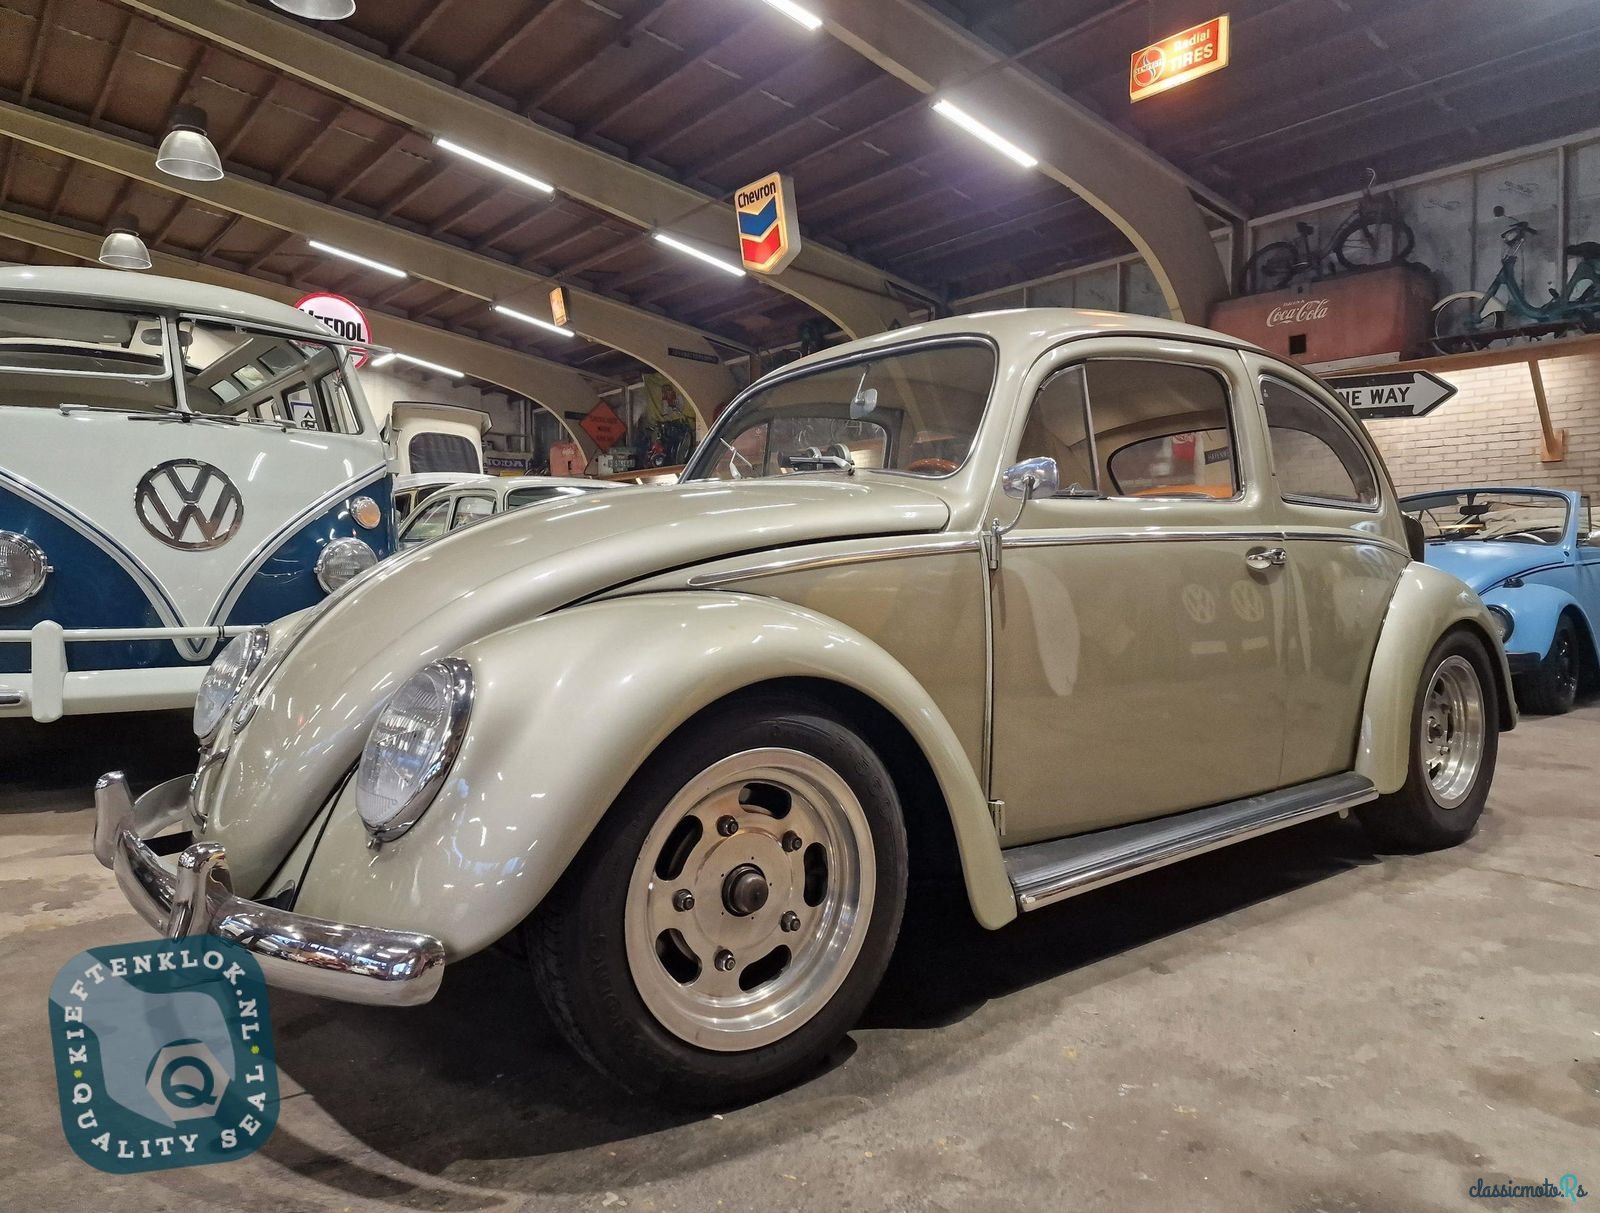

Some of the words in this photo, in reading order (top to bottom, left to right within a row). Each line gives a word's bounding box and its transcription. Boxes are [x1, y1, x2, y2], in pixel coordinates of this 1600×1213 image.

[1174, 28, 1210, 51] Radial
[1170, 43, 1213, 71] TIRES
[738, 182, 777, 208] Chevron
[1339, 390, 1362, 406] NE
[1370, 386, 1410, 404] WAY
[136, 459, 242, 549] VW
